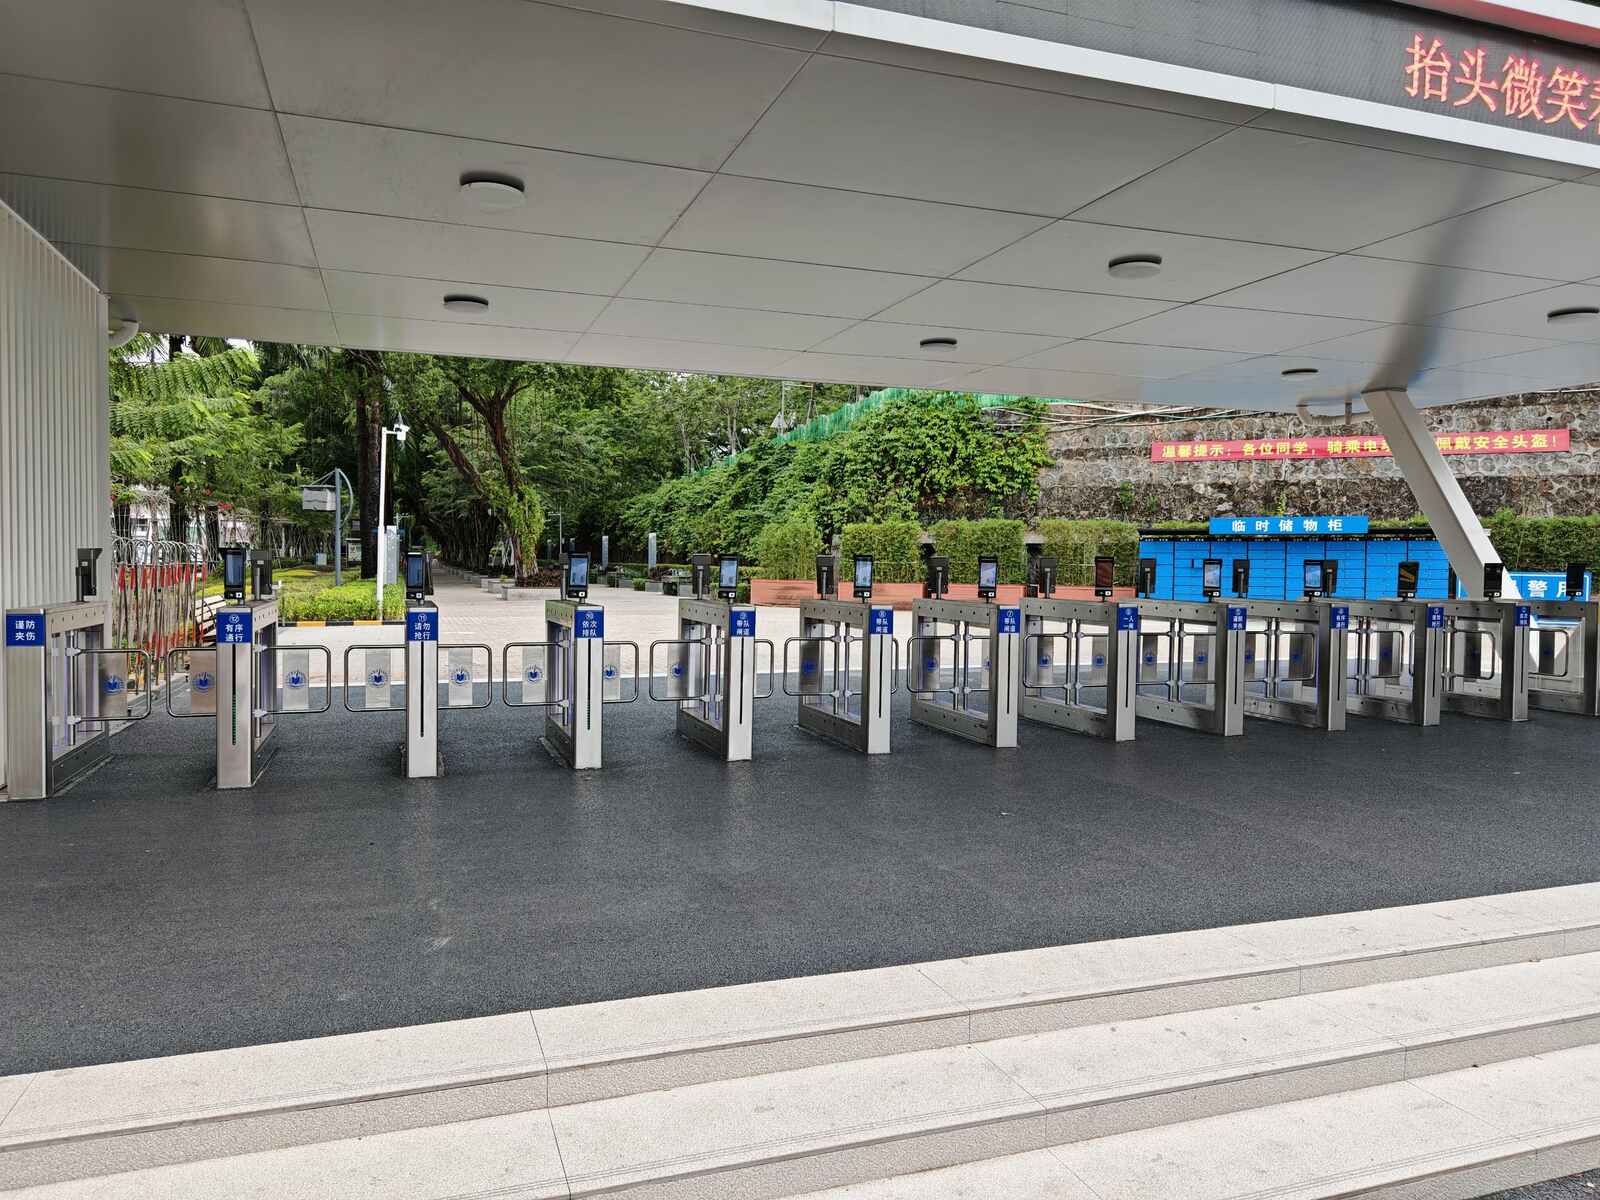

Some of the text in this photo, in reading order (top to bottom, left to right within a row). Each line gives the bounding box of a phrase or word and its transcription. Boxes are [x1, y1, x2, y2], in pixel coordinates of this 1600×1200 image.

[1405, 32, 1600, 136] 抬头微笑
[1231, 519, 1344, 532] 临时储物柜
[15, 620, 36, 630] 谨防
[224, 623, 243, 632] 有序
[414, 622, 431, 631] 请勿
[582, 620, 597, 629] 依次
[15, 632, 36, 641] 夹伤
[225, 633, 244, 642] 通行
